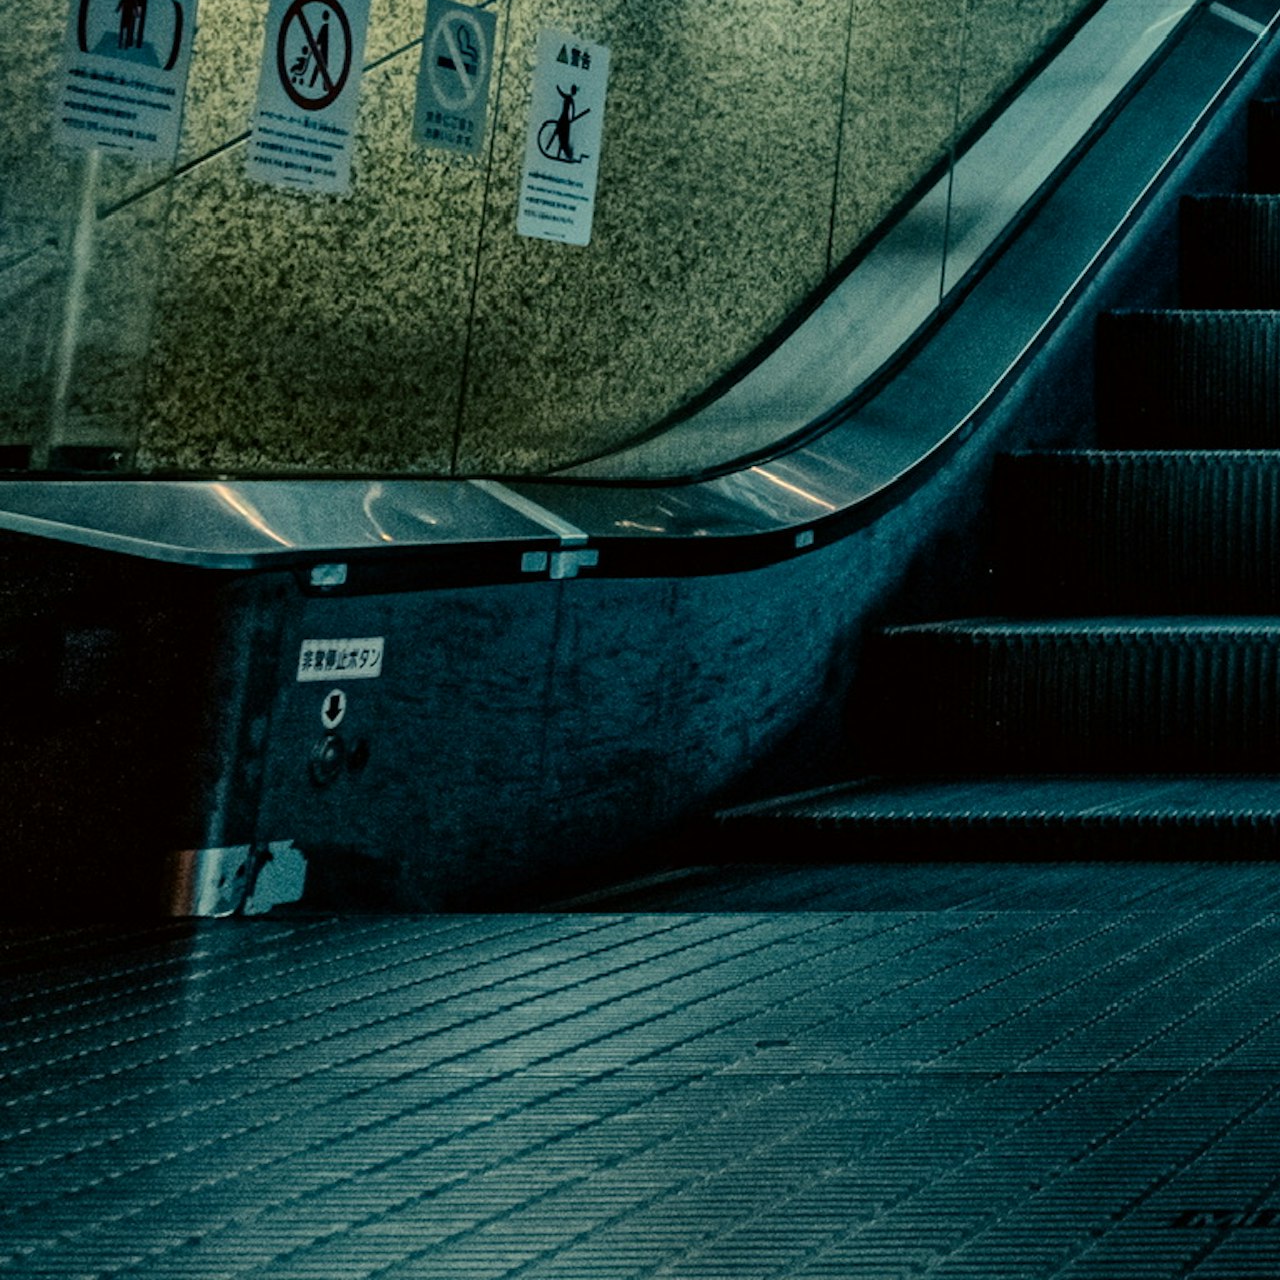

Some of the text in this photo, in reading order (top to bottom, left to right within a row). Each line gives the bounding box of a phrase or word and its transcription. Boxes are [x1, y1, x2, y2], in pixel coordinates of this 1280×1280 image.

[570, 47, 592, 70] 警告
[301, 648, 381, 671] 非常停止ボタン
